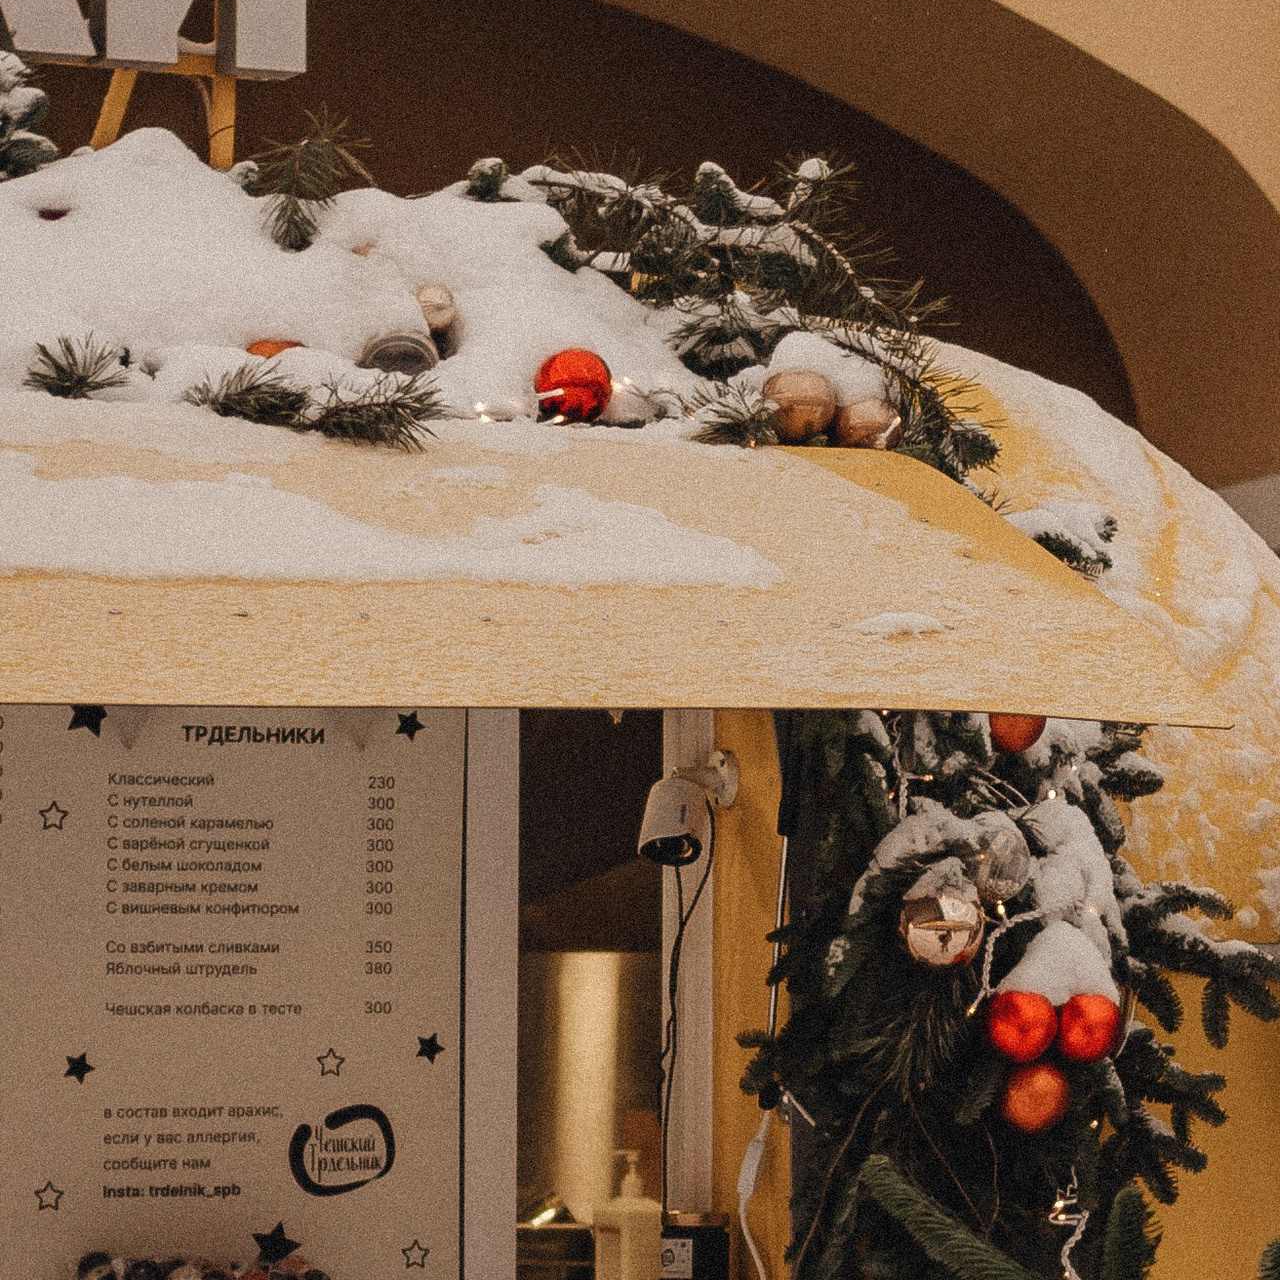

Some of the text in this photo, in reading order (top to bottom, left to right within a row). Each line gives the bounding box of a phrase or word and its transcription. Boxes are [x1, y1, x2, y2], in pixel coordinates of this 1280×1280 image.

[182, 725, 325, 746] ТРДЕЛЬНИКИ
[108, 773, 395, 790] Классический 230
[106, 793, 395, 811] С нутеллой 300
[106, 815, 119, 829] С
[190, 818, 274, 833] карамелью
[367, 818, 394, 831] 300
[106, 836, 394, 854] С варёной сгущенкой 300
[106, 857, 393, 874] С белым шоколадом 300
[106, 879, 393, 896] С заварным кремом 300
[106, 901, 393, 918] С вишневым конфитюром 300
[105, 940, 392, 954] Со взбитыми сливками 350
[105, 962, 392, 978] Яблочный штрудель 380
[105, 1002, 171, 1016] Чешская
[175, 1001, 244, 1016] колбаска
[262, 1004, 302, 1016] тесте
[365, 1001, 392, 1015] 300
[116, 1106, 168, 1119] состав
[172, 1106, 224, 1120] входит
[227, 1104, 284, 1119] арахис,
[103, 1132, 139, 1144] если
[156, 1133, 182, 1144] вас
[103, 1157, 211, 1173] сообщите нам
[103, 1183, 241, 1200] Insta: trdelnik_spb
